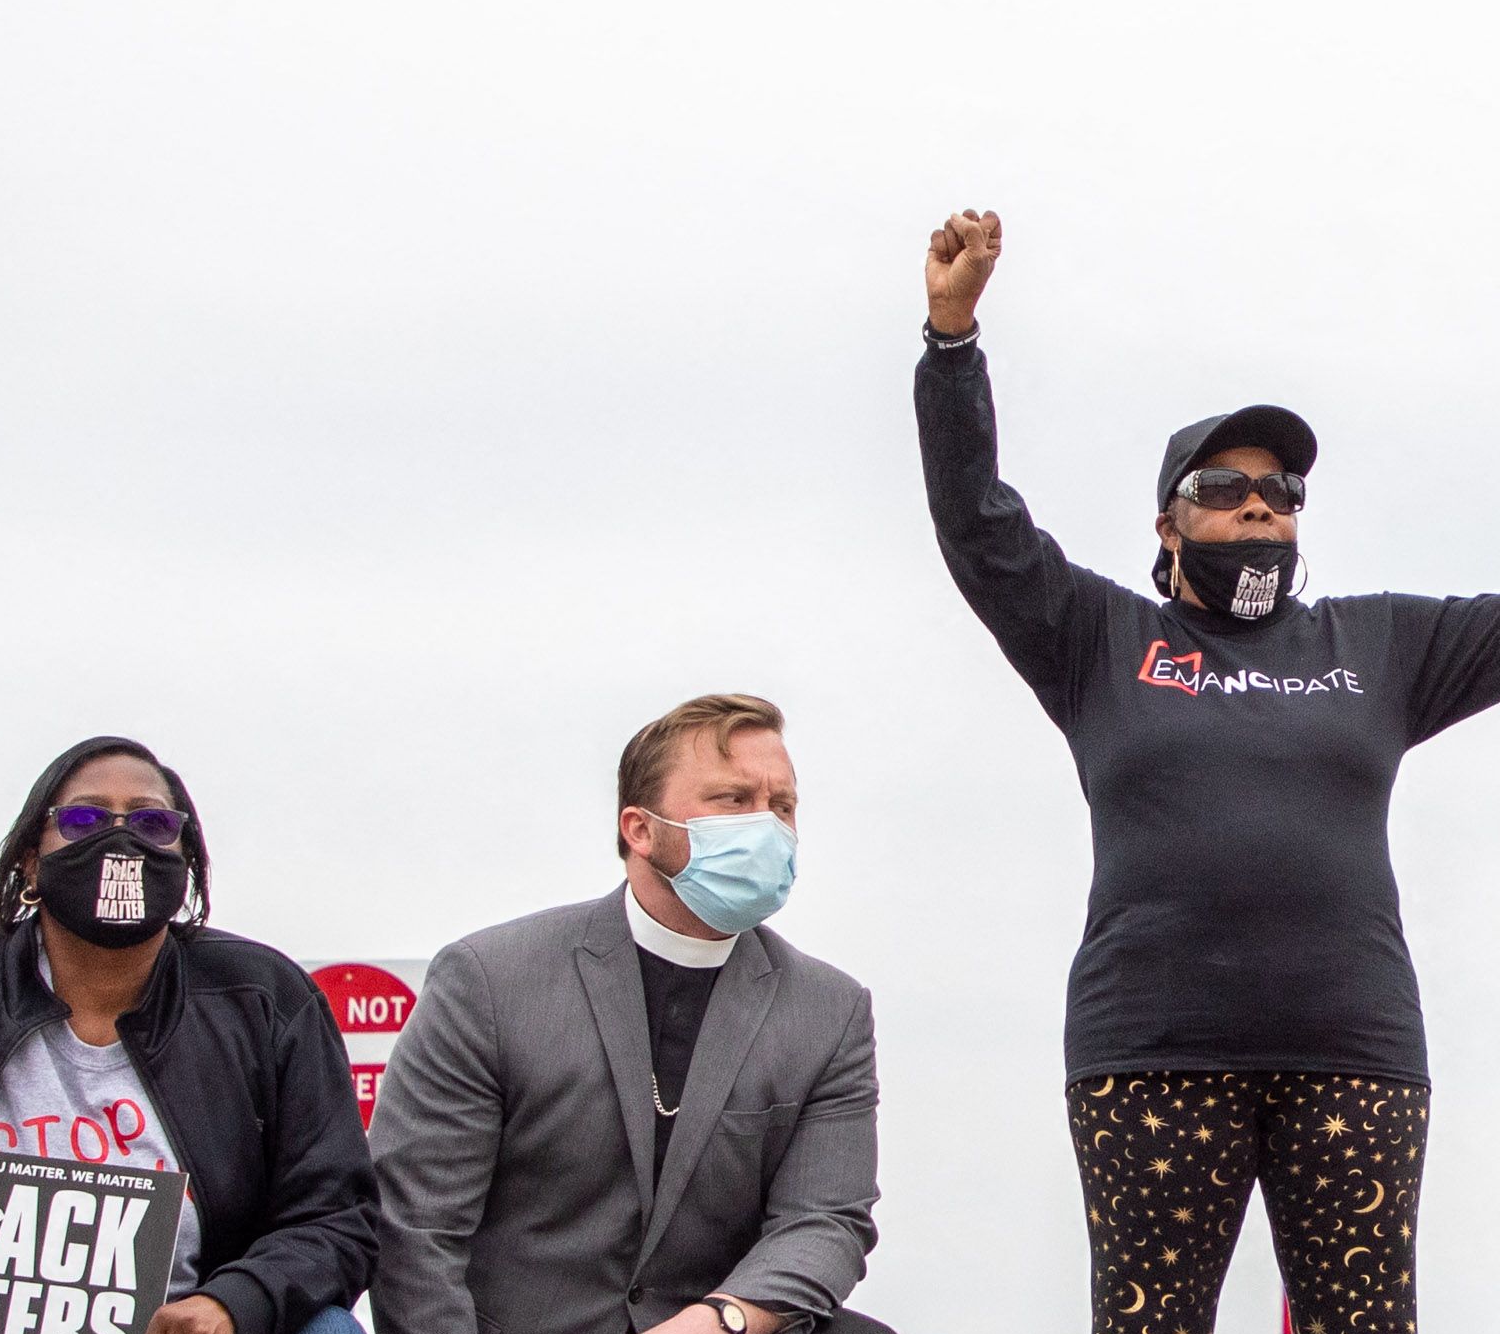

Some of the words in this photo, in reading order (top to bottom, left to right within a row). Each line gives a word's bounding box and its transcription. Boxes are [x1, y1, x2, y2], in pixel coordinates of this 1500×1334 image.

[1236, 587, 1276, 601] VOTERS
[1231, 598, 1274, 615] MATTER
[1153, 659, 1364, 695] EMANCIPATE
[100, 880, 144, 899] VOTERS
[96, 899, 145, 919] MATTER
[347, 996, 407, 1024] NOT
[9, 1162, 67, 1180] MATTER.
[72, 1170, 94, 1183] WE
[97, 1173, 156, 1190] MATTER.
